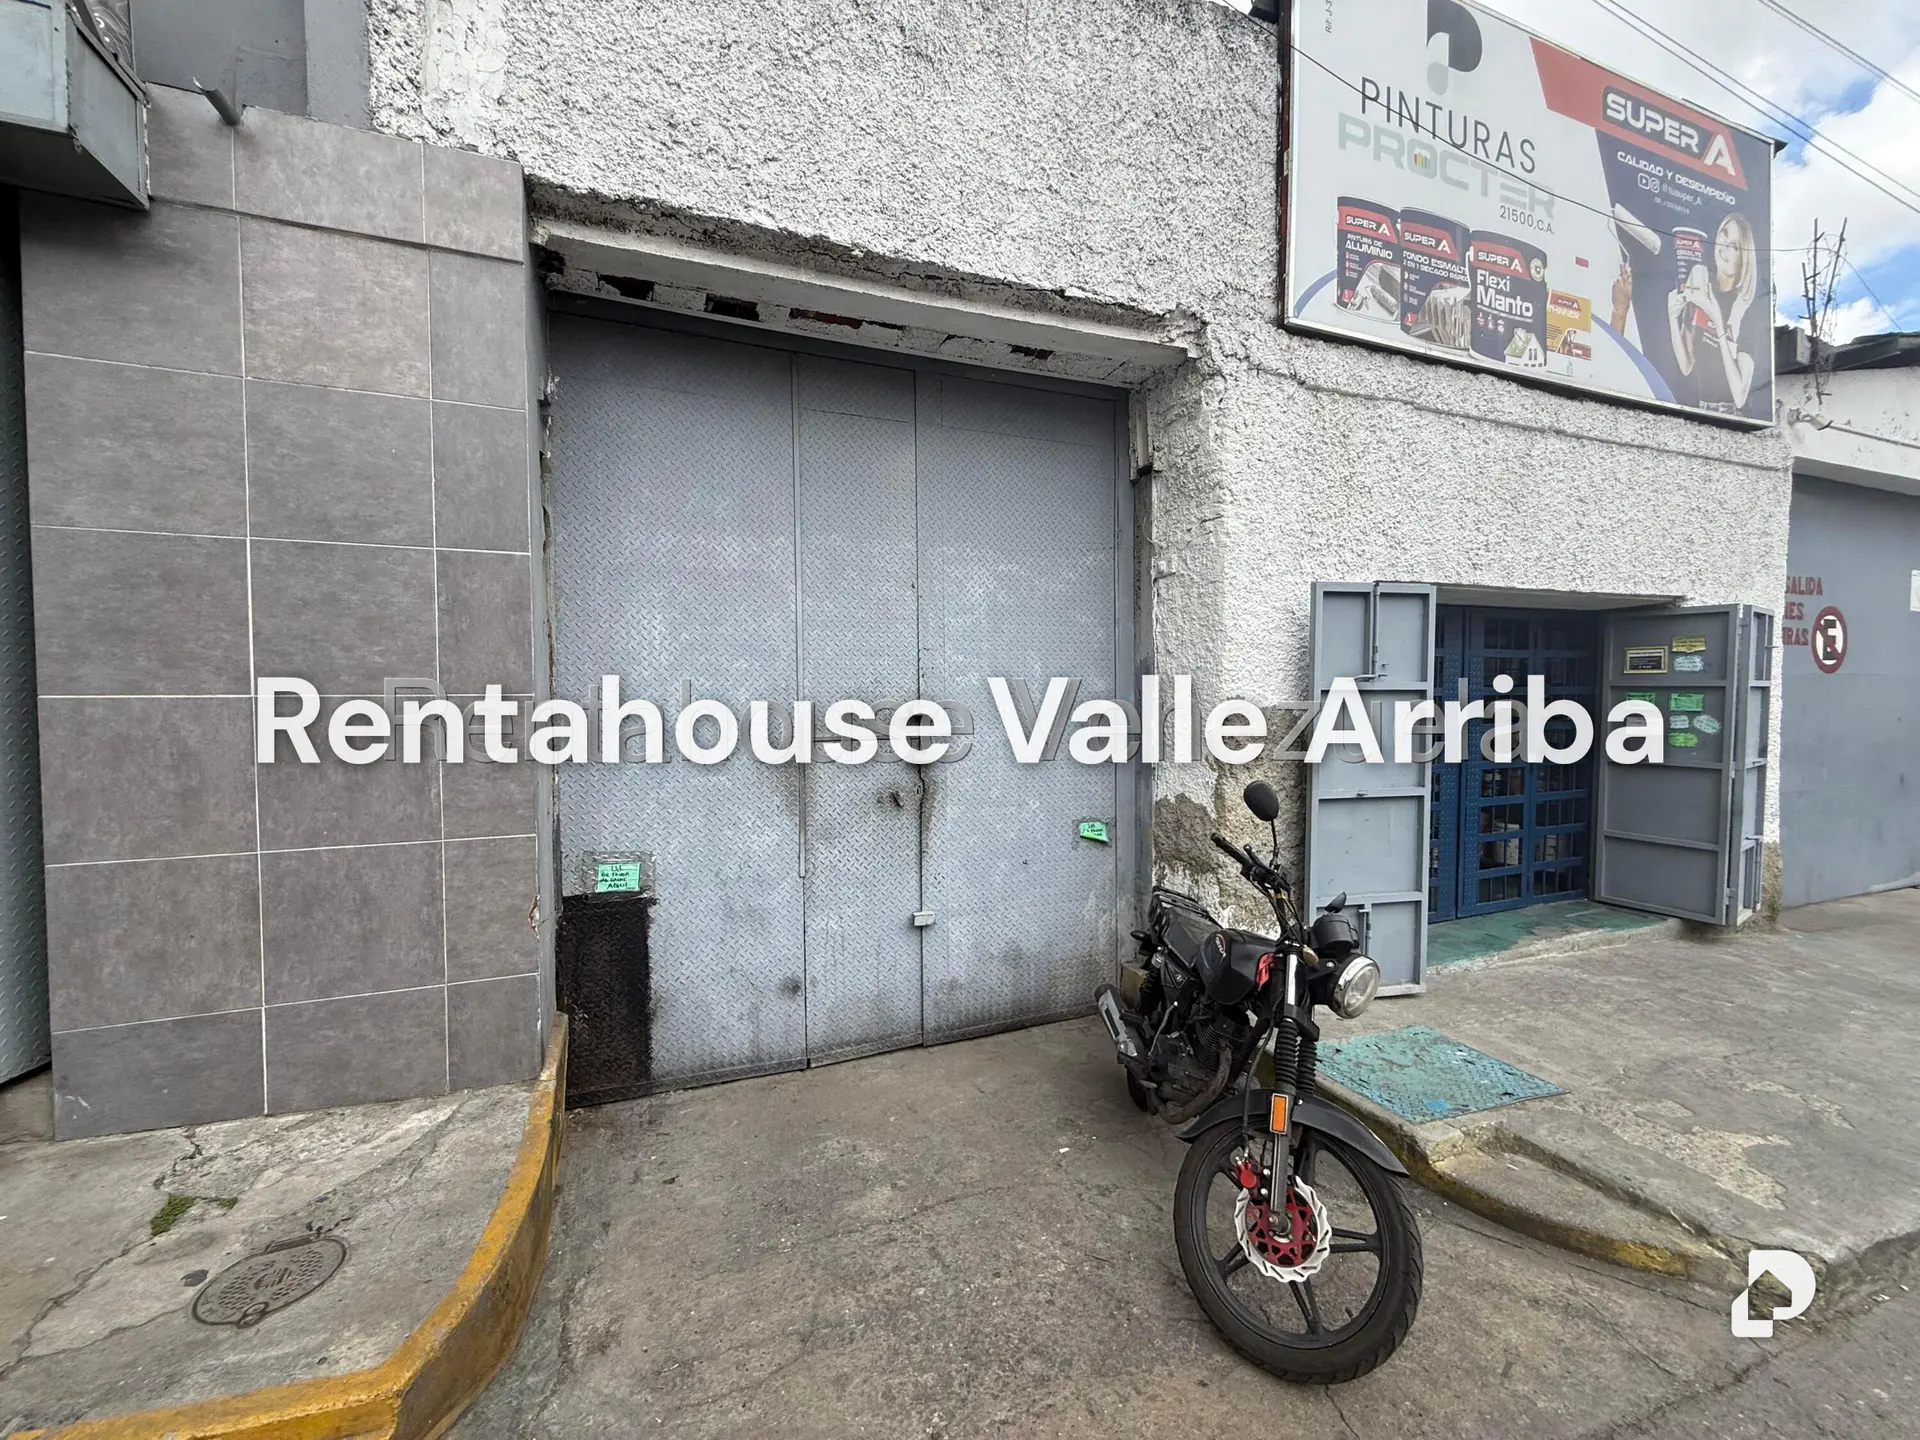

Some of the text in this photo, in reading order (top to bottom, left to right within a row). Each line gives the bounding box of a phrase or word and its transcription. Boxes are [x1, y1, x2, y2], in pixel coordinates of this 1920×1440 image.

[1361, 76, 1536, 174] PINTURAS
[1606, 92, 1736, 176] SUPER A
[1337, 112, 1555, 219] PROCTER
[1617, 151, 1664, 176] CALIDAD
[1666, 170, 1673, 180] Y
[1675, 174, 1736, 205] DESEMPEÑO
[1345, 215, 1390, 237] SUPER A
[1500, 205, 1555, 235] 21500,C.A.
[1345, 240, 1393, 260] ALUMINIO
[1404, 232, 1451, 254] SUPER A
[1403, 250, 1429, 265] FONDO
[1478, 251, 1523, 273] SUPER A
[1420, 264, 1448, 278] SECADO
[1477, 269, 1511, 292] Flexi
[1477, 284, 1533, 317] Manto
